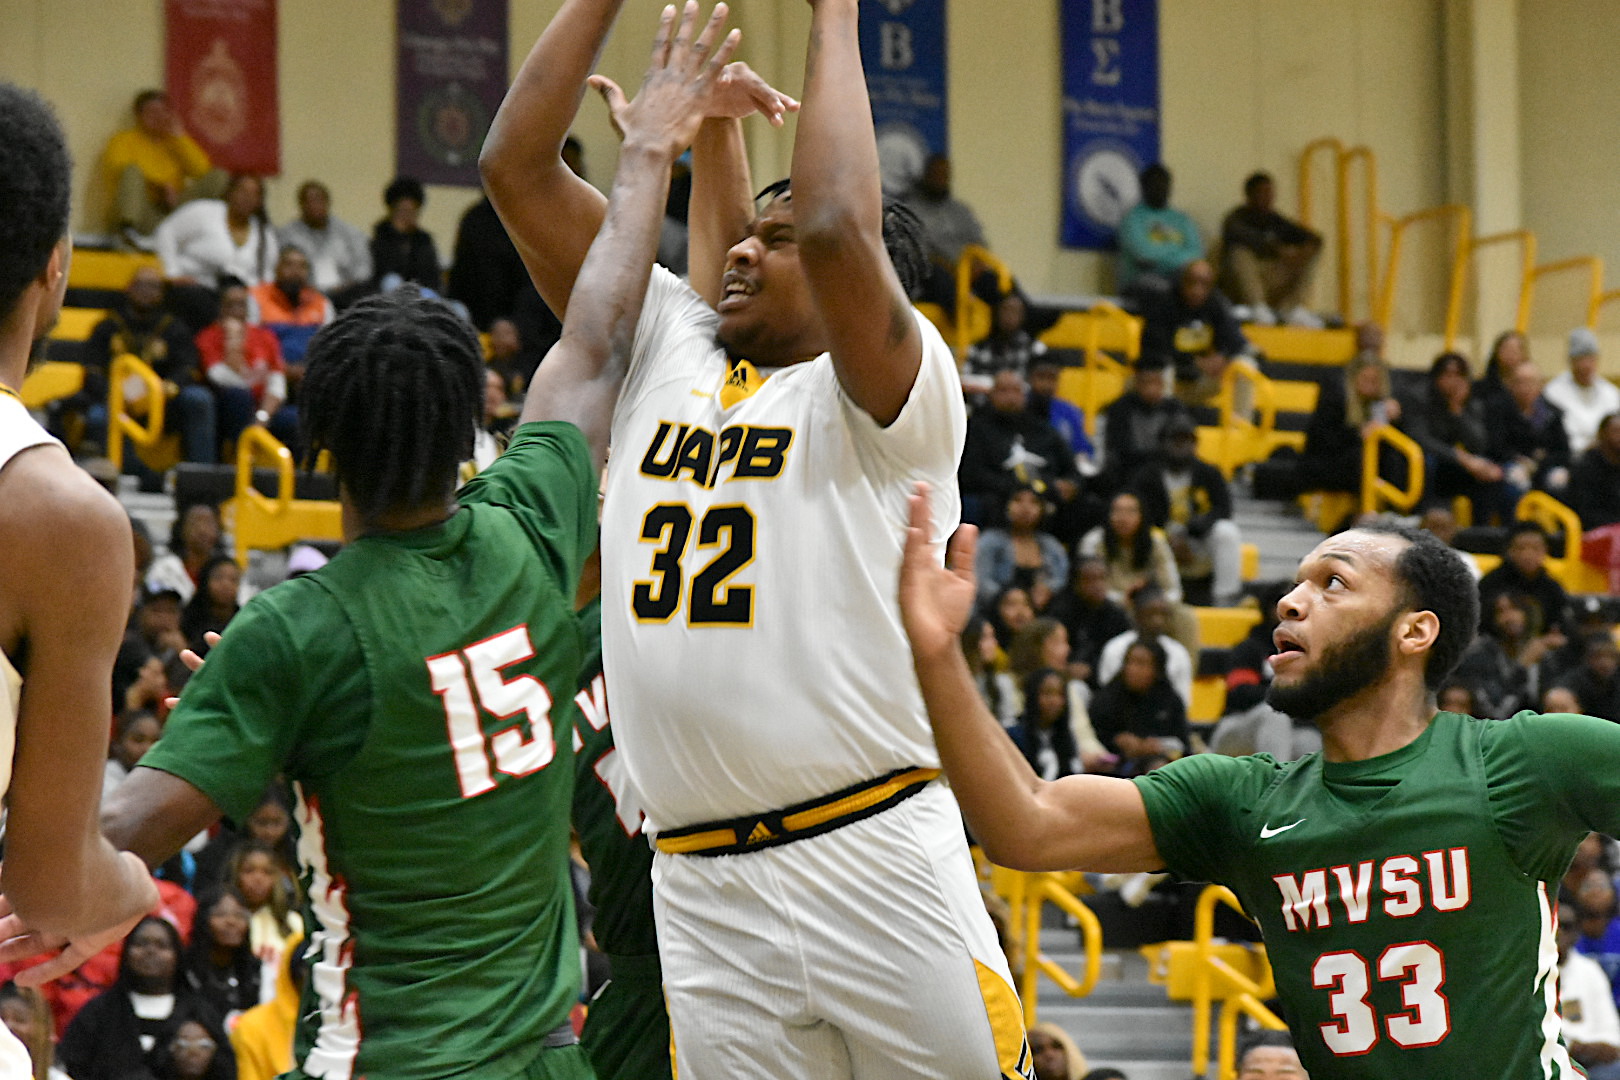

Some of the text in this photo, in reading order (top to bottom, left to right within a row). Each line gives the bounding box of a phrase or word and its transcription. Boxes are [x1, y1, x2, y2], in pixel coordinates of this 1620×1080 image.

[639, 420, 796, 491] UAPB
[630, 501, 757, 629] 32
[424, 622, 557, 799] 15
[1272, 846, 1472, 932] MVSU
[1311, 940, 1451, 1057] 33
